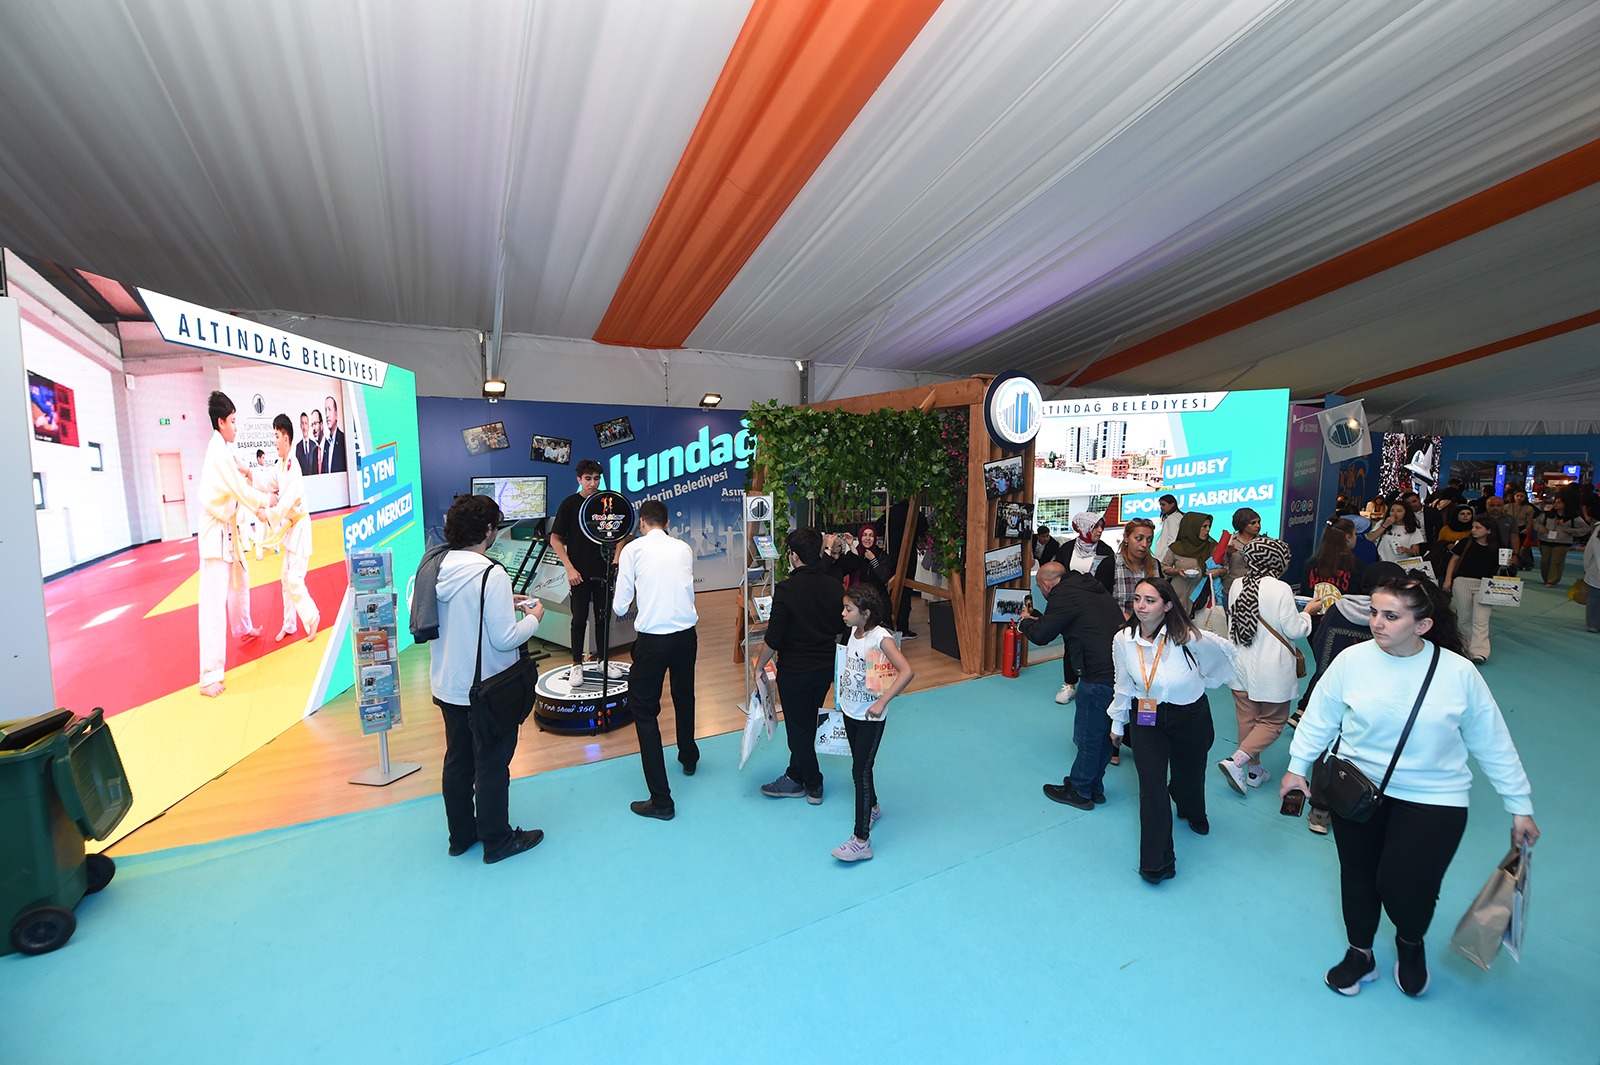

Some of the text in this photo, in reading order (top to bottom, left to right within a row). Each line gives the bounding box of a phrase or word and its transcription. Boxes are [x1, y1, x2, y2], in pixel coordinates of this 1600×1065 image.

[178, 313, 378, 383] ALTINDAĞ BELEDİYESİ
[1042, 394, 1207, 415] LTINDAĞ BELEDİYESİ
[363, 466, 371, 489] 5
[1165, 457, 1229, 479] ULUBEY
[673, 467, 728, 497] Belediyesi
[1123, 491, 1184, 515] SPORU
[345, 514, 375, 549] SPOR
[577, 704, 595, 713] 360
